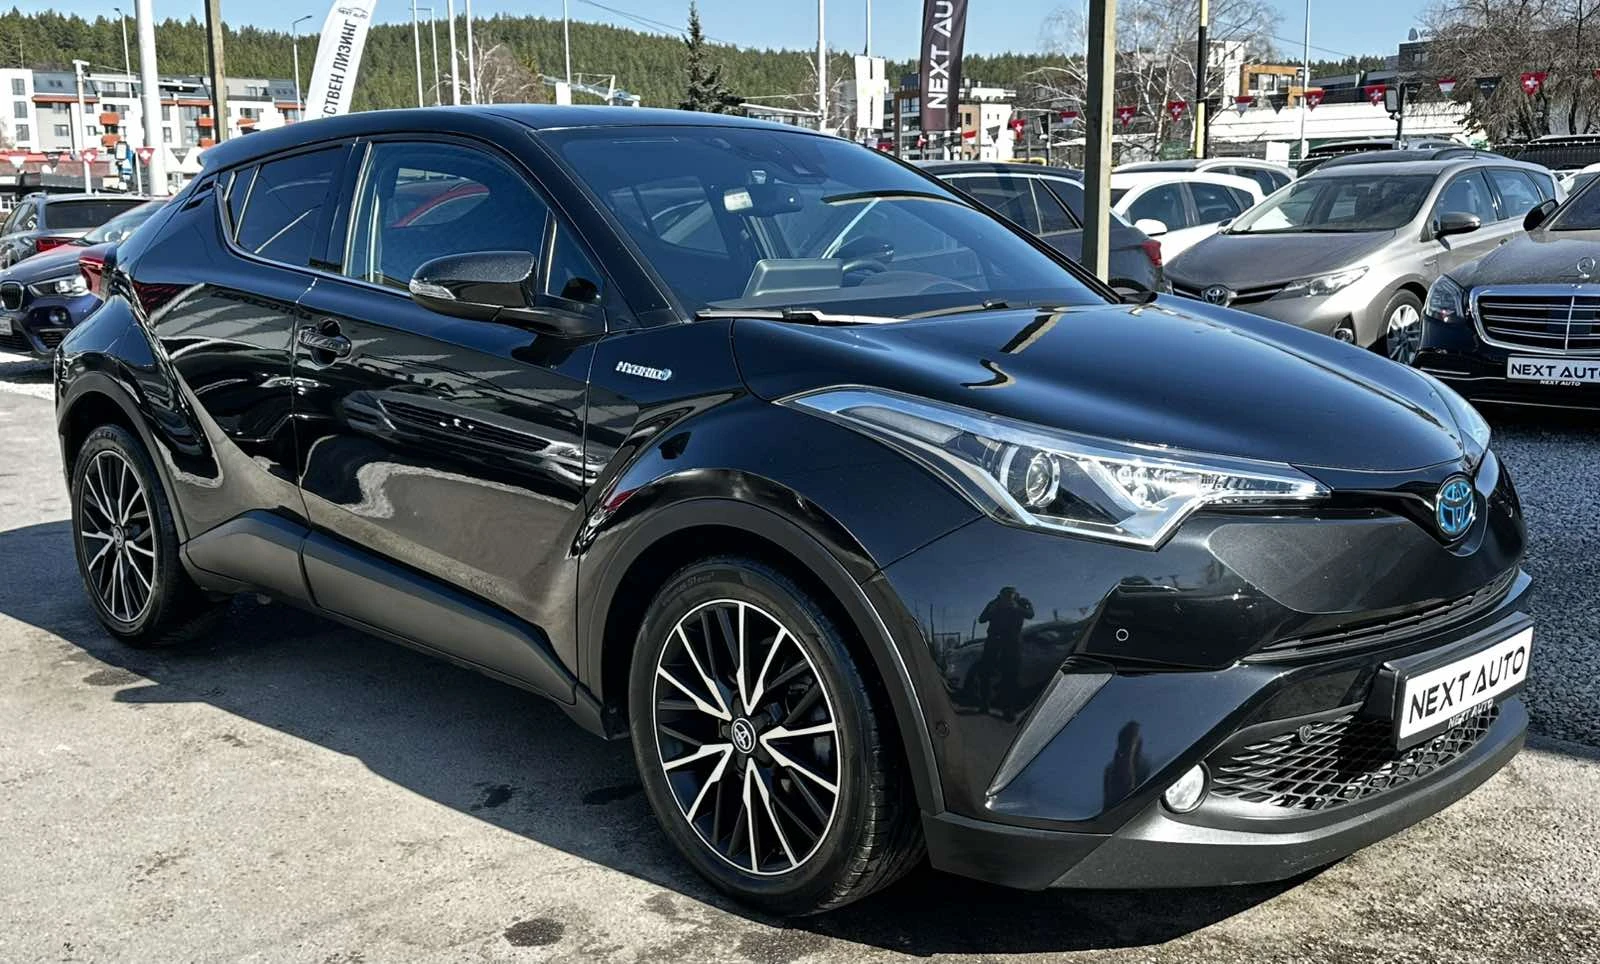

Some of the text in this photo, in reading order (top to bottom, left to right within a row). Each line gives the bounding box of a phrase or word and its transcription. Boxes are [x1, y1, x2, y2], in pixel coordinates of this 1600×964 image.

[333, 19, 357, 73] ЛИЗИНГ
[927, 43, 950, 109] NEXT
[615, 361, 663, 380] HYBRID
[1511, 364, 1600, 379] NEXT AUT
[1409, 645, 1526, 724] NEXT AUTO
[1448, 698, 1493, 729] NEXT AUTO
